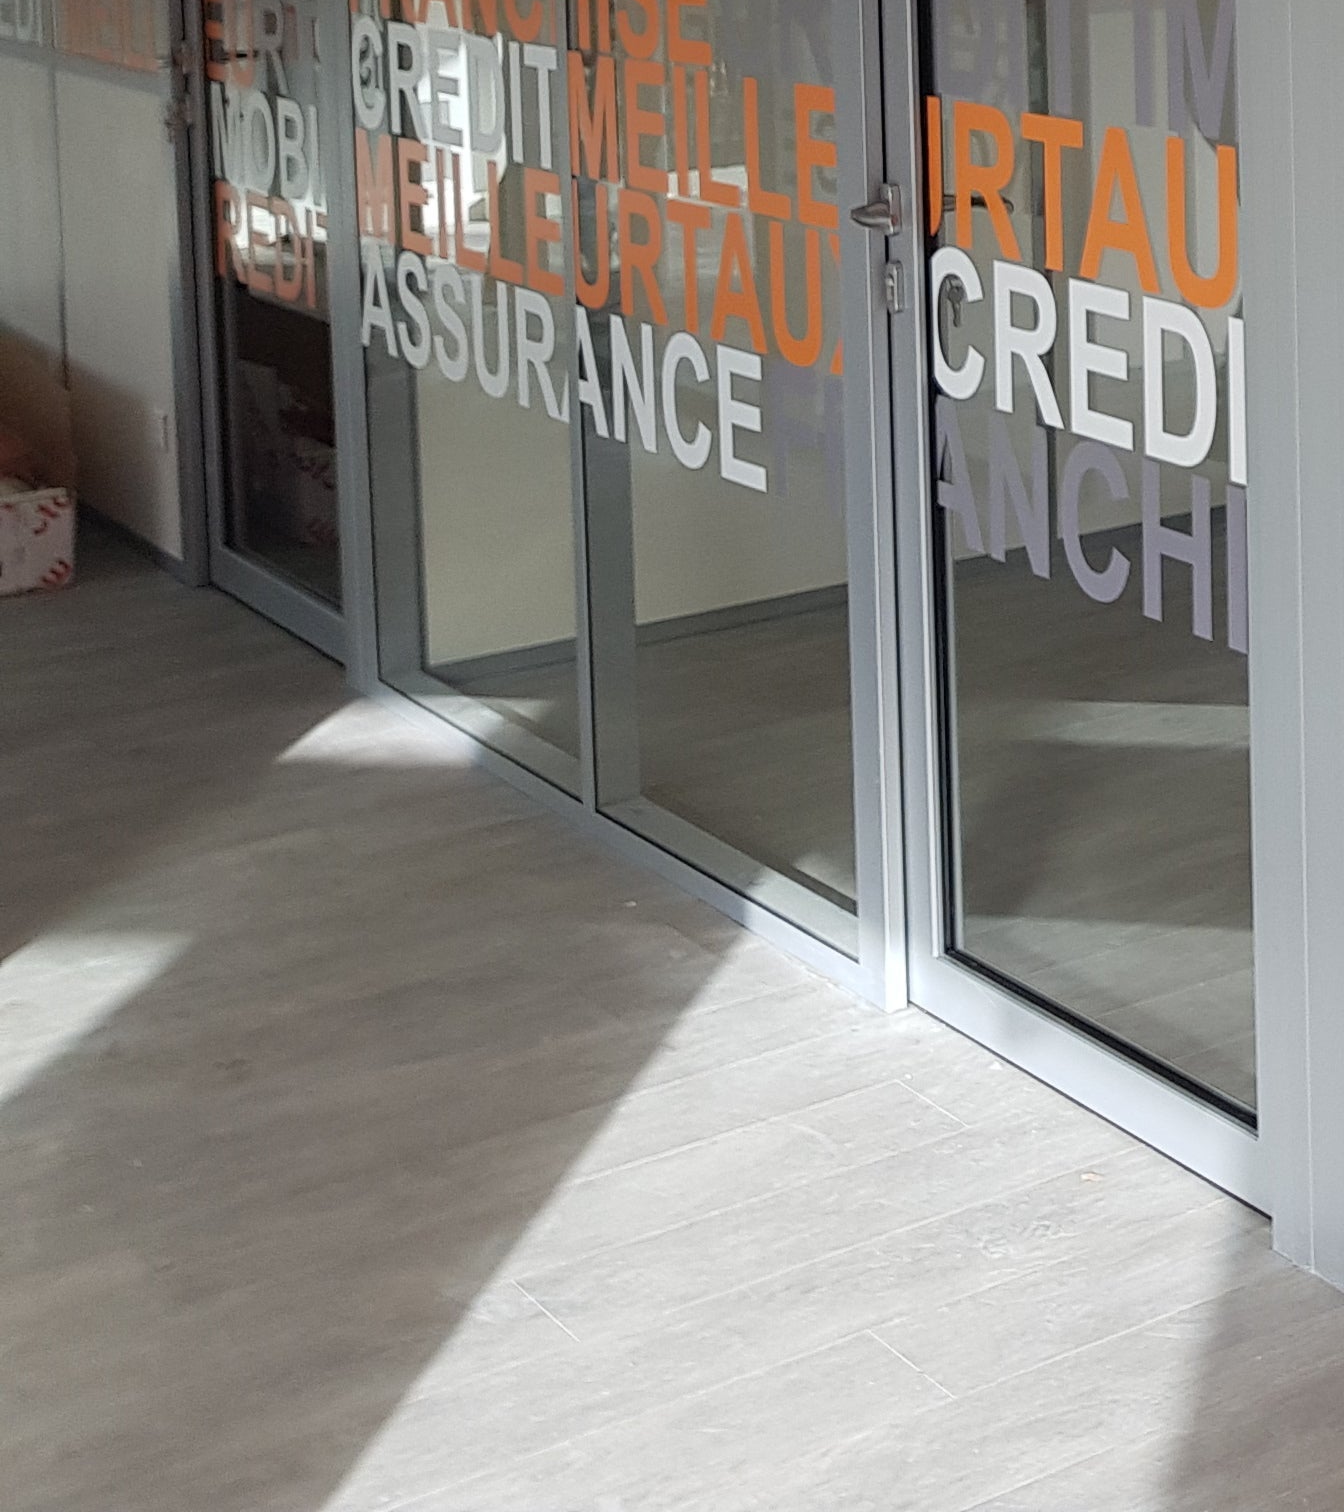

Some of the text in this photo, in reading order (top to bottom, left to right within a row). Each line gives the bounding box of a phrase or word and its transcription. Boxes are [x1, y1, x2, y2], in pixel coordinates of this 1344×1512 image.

[352, 14, 838, 229] CREDIT MEILLE
[355, 126, 844, 377] MEILLEURTAU
[361, 250, 769, 494] ASSURANCE
[930, 245, 1249, 489] CREDI
